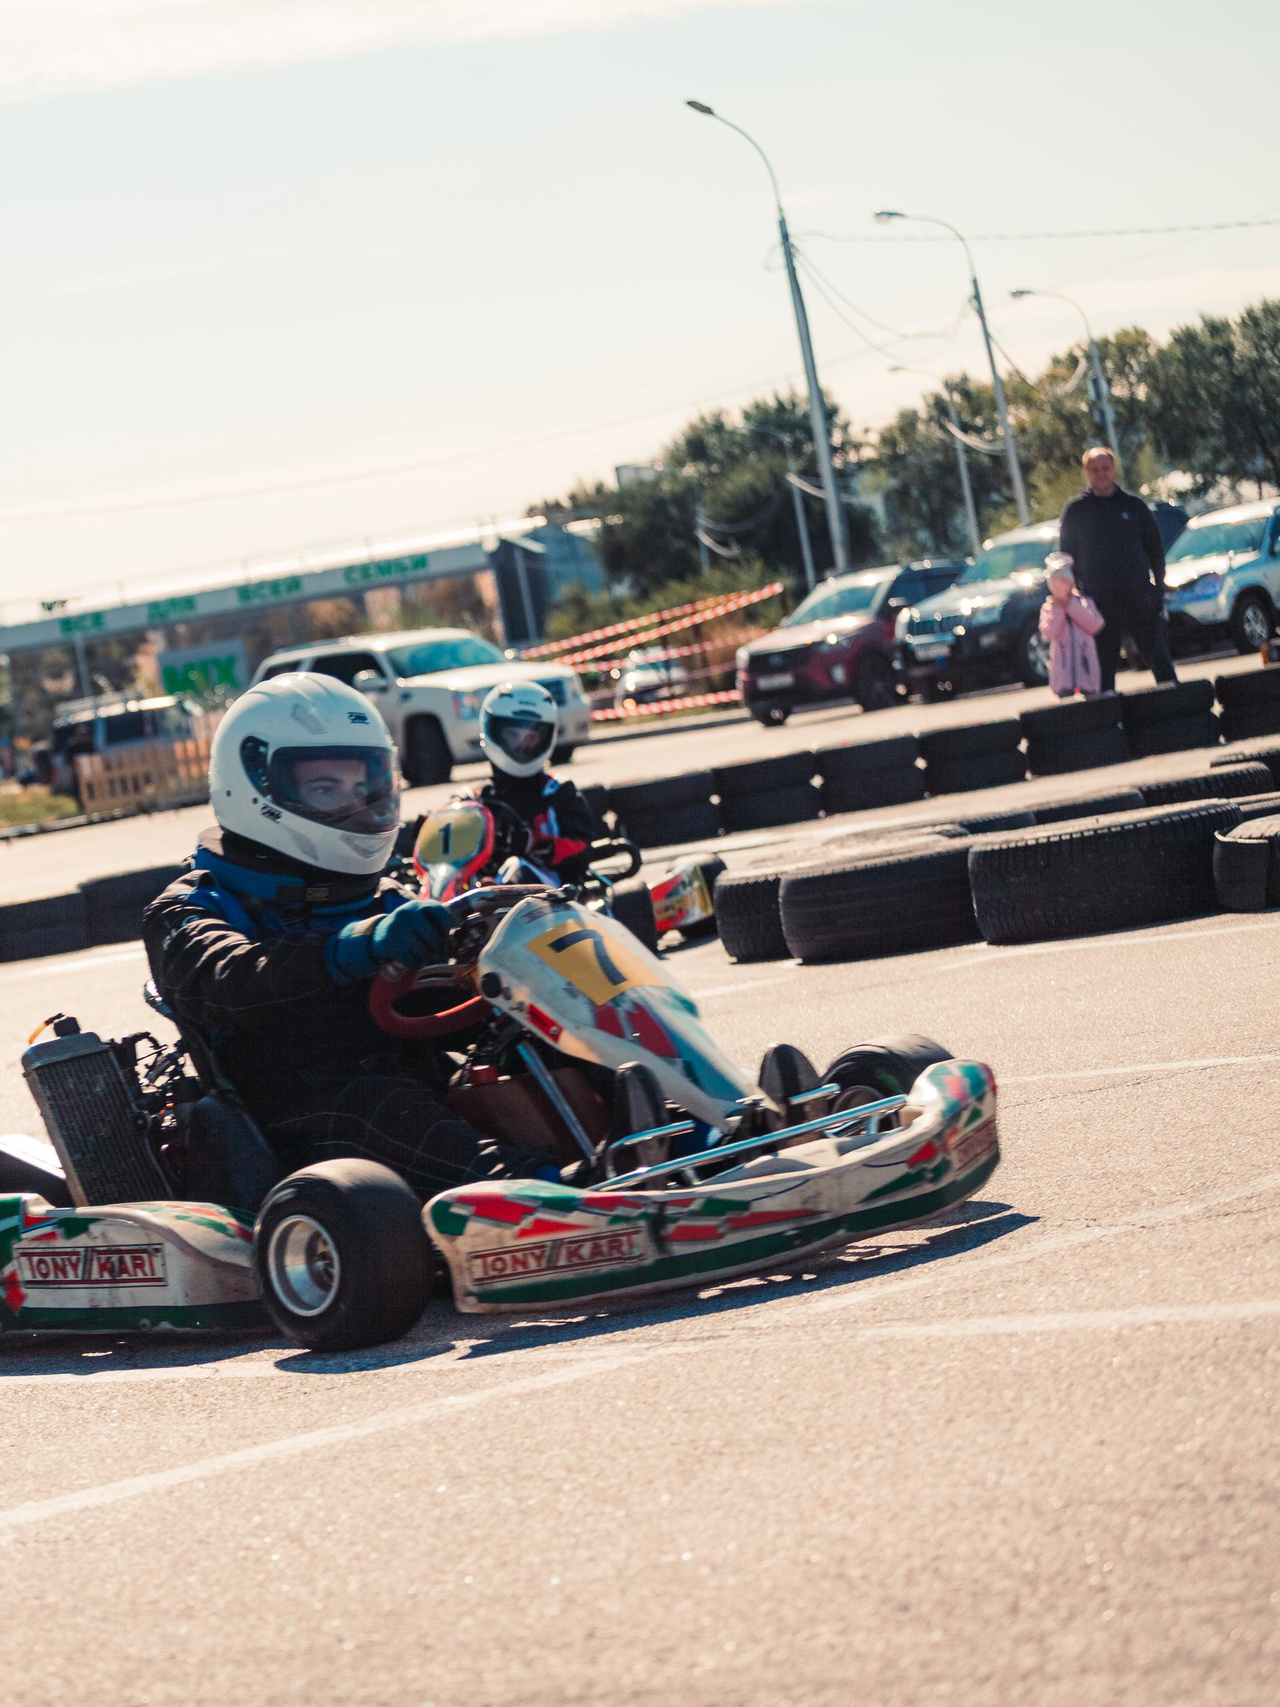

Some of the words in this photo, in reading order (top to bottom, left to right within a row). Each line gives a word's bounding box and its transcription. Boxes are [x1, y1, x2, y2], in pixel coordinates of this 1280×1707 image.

[439, 822, 451, 854] 1
[547, 929, 629, 986] 7
[22, 1251, 81, 1279] TONY
[95, 1249, 158, 1278] KART
[473, 1245, 547, 1277] TONY
[565, 1231, 640, 1264] KART
